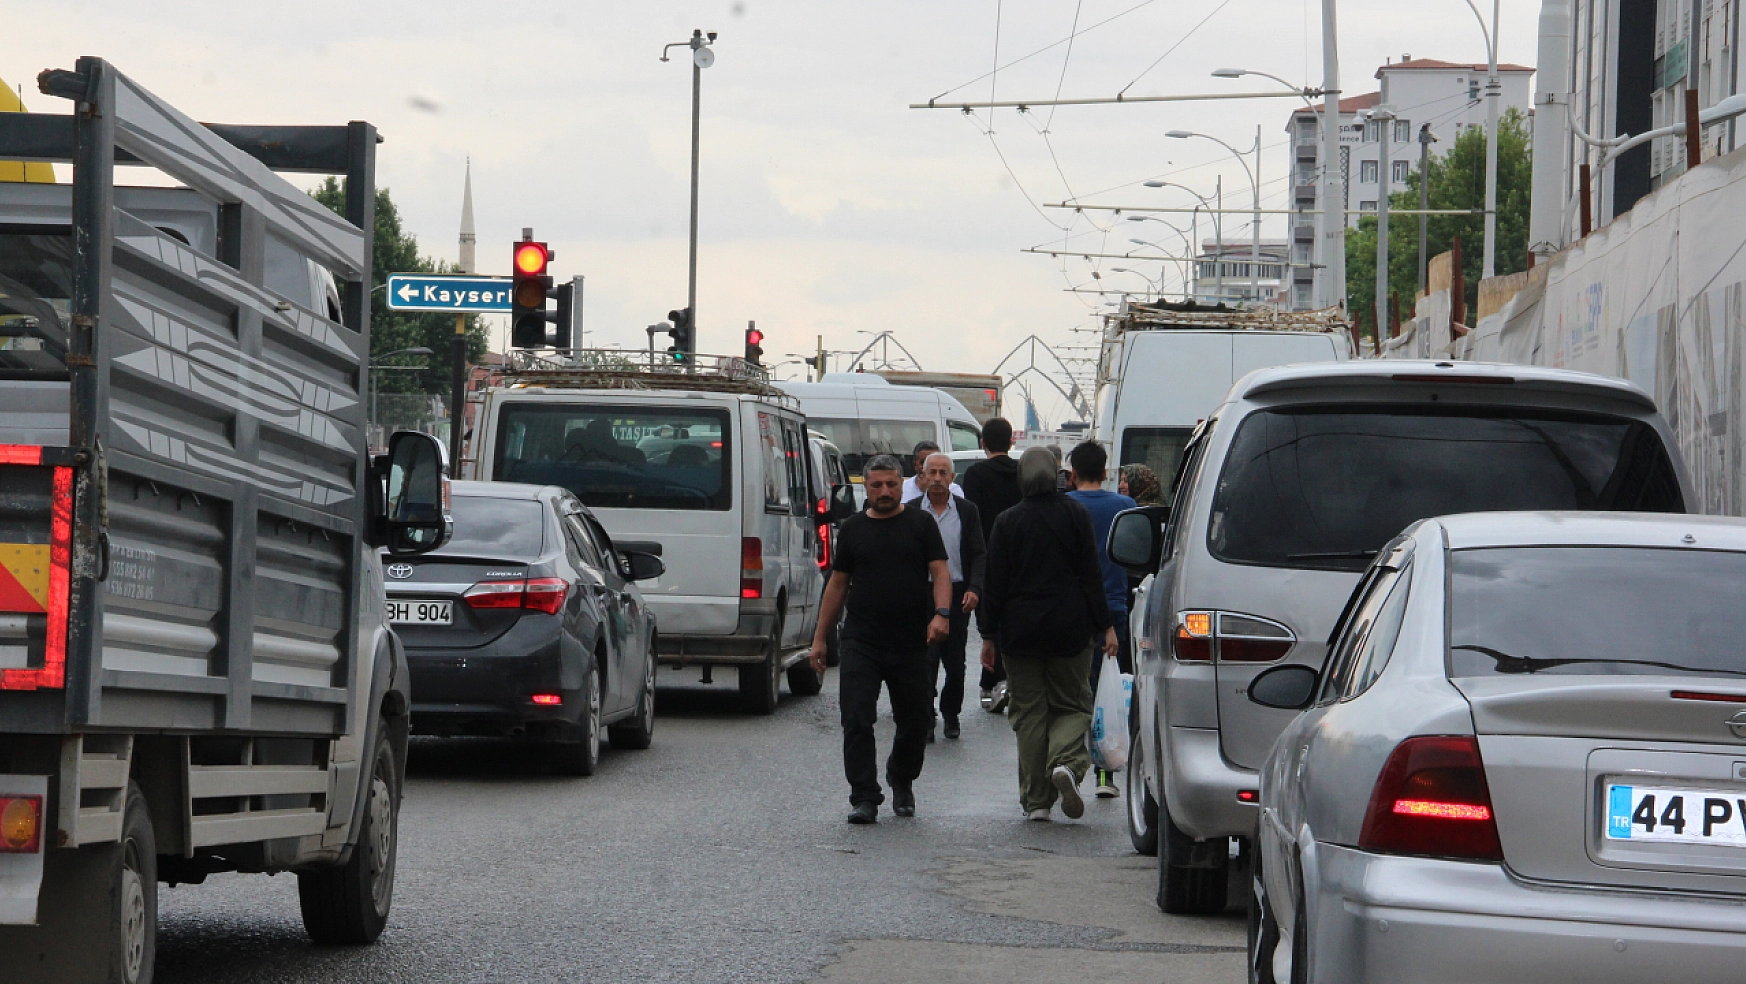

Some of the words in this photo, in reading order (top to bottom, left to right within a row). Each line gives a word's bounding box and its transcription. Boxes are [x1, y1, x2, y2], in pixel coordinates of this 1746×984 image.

[424, 285, 513, 306] Kayseri
[418, 603, 450, 621] 904
[1612, 815, 1630, 828] TR
[1631, 793, 1687, 835] 44
